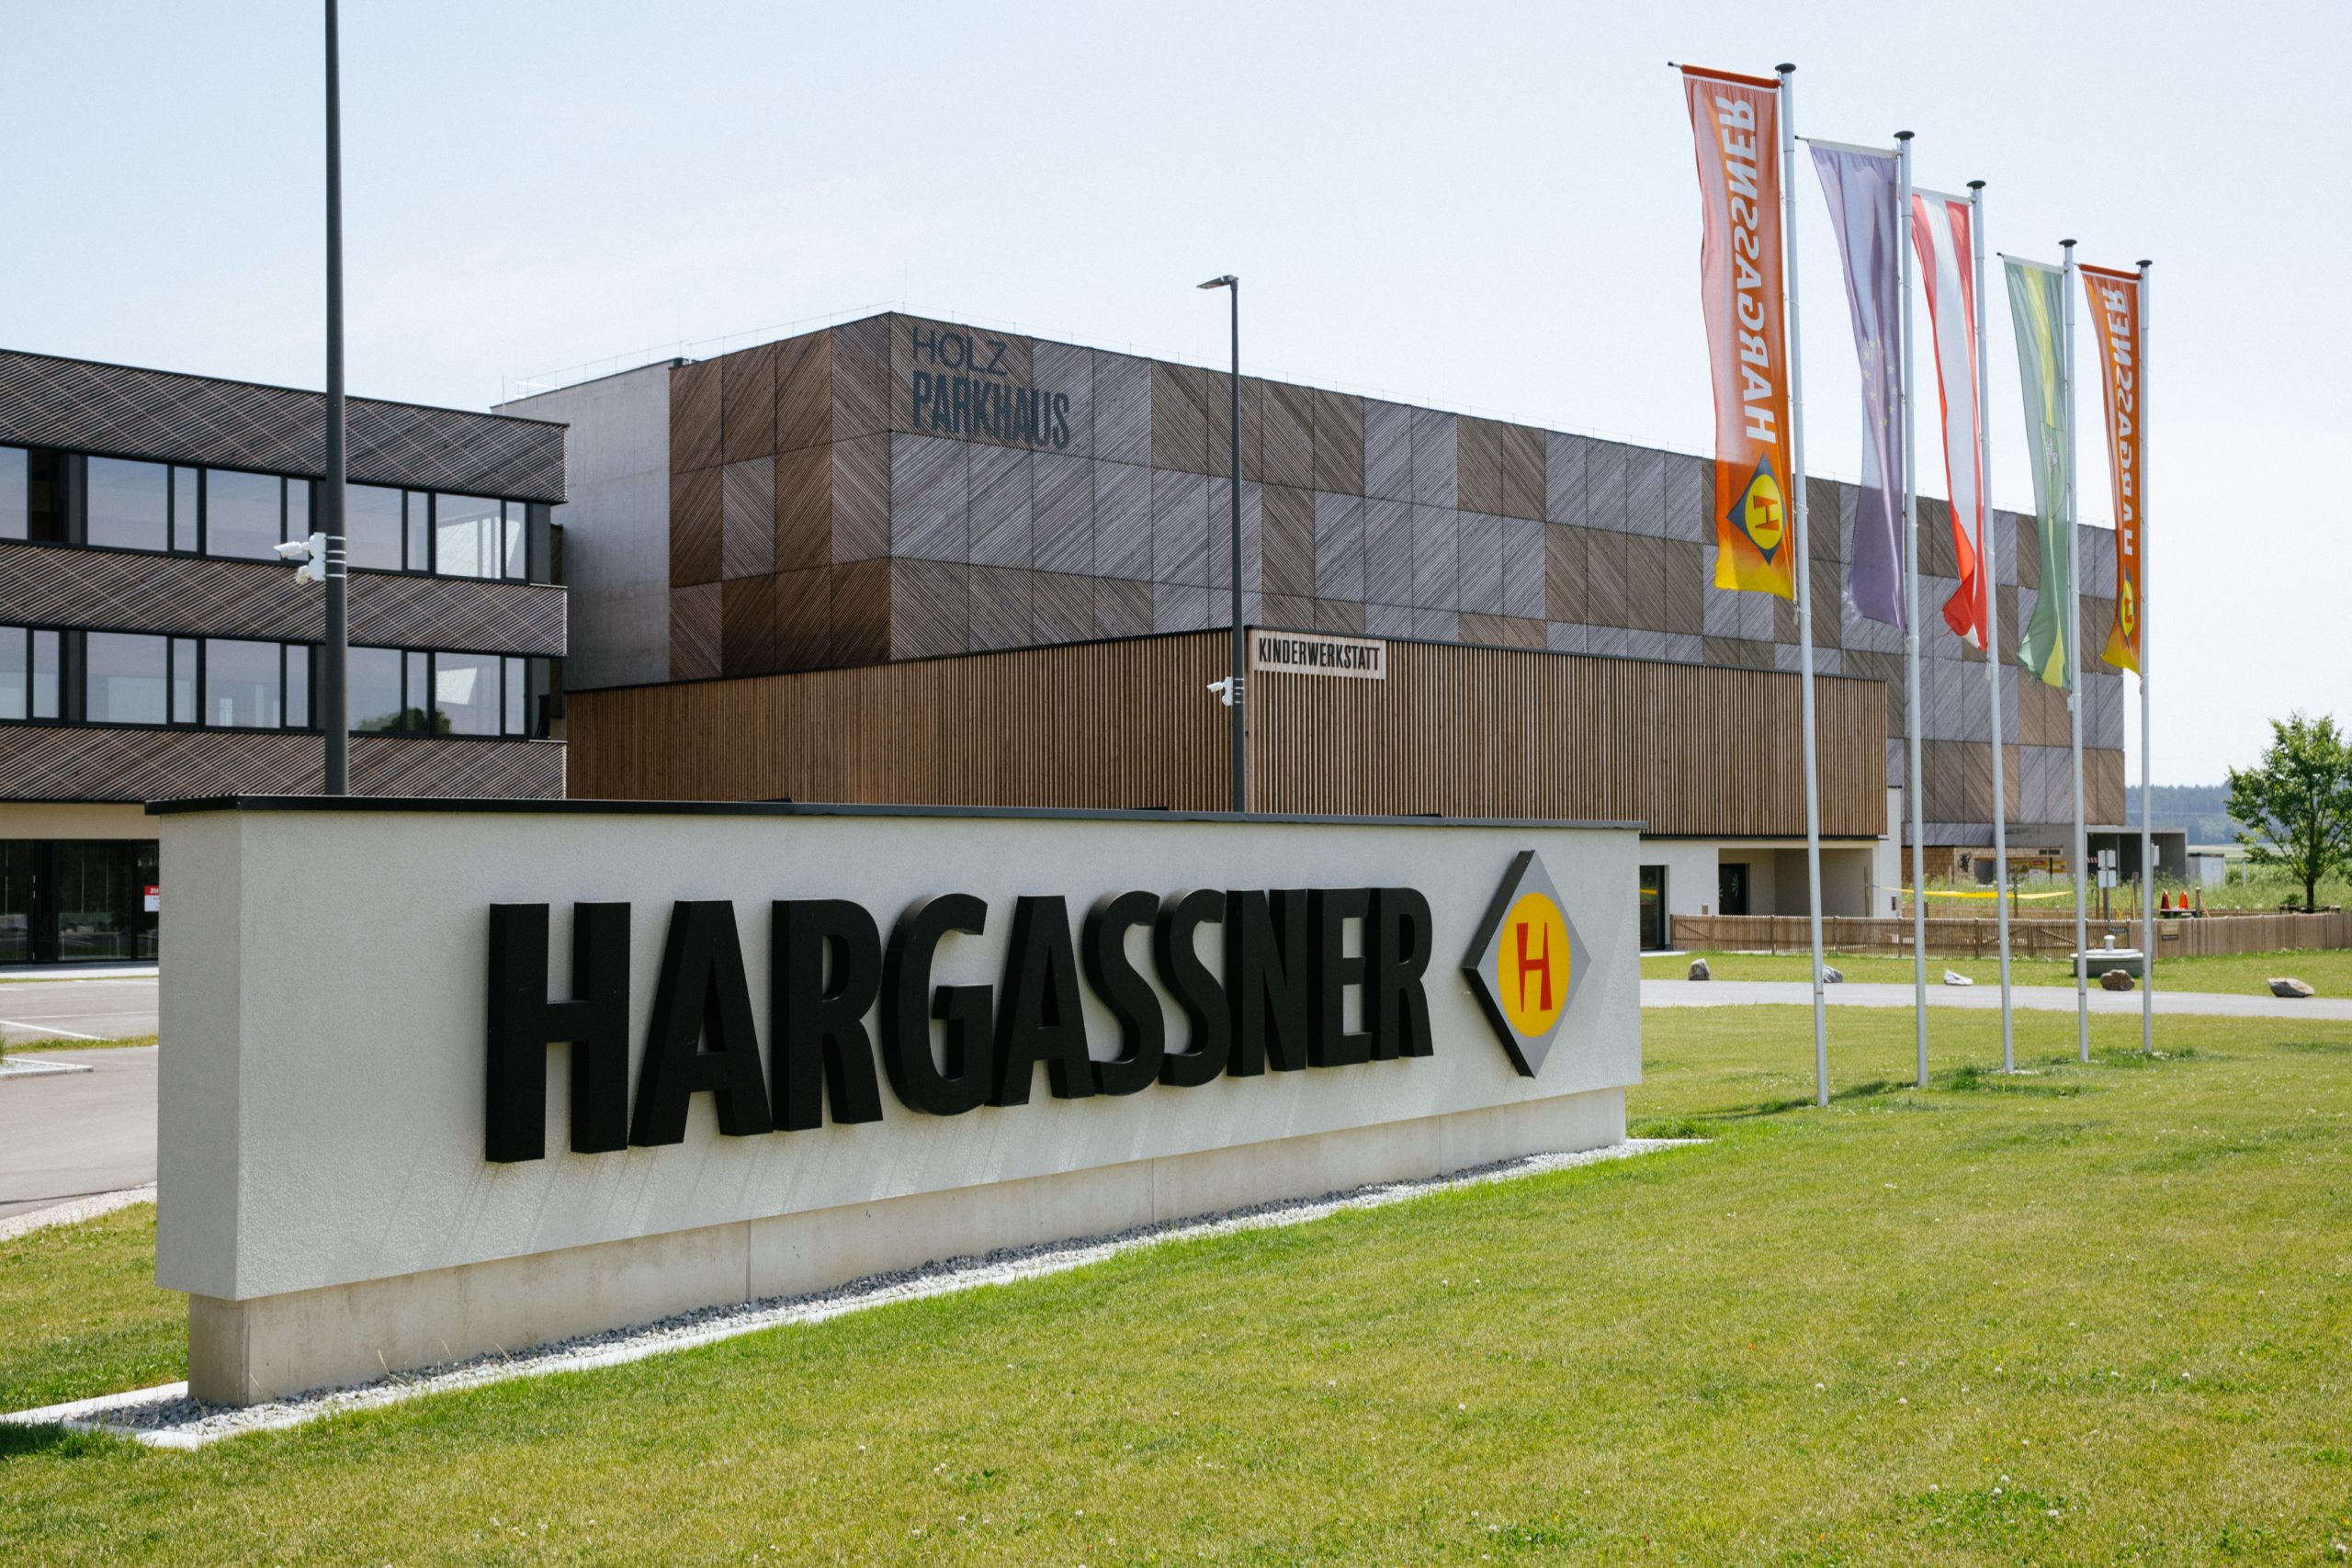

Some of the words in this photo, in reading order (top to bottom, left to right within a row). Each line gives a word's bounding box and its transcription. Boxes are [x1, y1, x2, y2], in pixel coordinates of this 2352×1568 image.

[911, 326, 1008, 377] HOLZ
[912, 369, 1069, 449] PARKHAUS
[1260, 637, 1379, 671] KINDERWERKSTATT
[1516, 921, 1553, 1013] H
[485, 888, 1433, 1163] HARGASSNER
